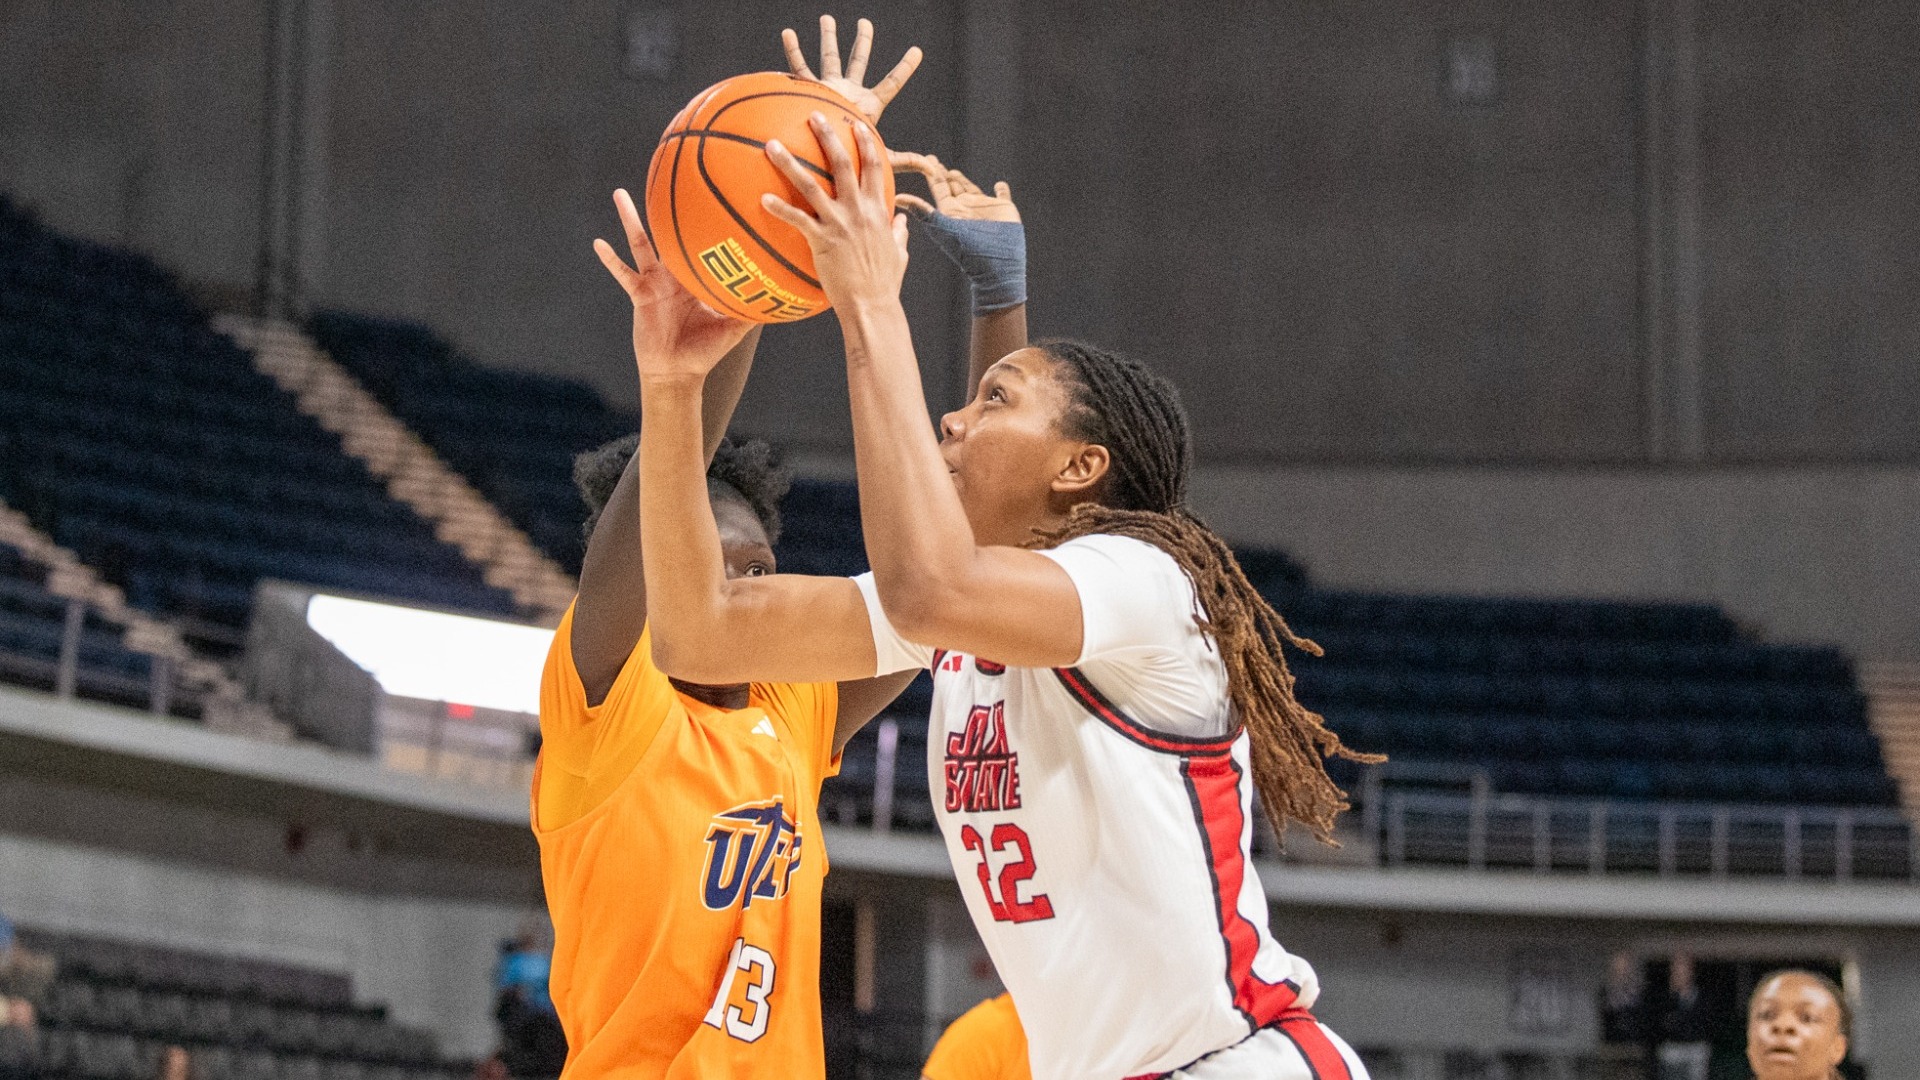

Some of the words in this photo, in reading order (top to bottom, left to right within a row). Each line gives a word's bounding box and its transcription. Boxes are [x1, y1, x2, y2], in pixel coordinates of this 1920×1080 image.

[698, 241, 818, 319] ELITE
[944, 752, 1022, 813] STATE
[961, 822, 1055, 924] 22
[702, 936, 776, 1044] 13
